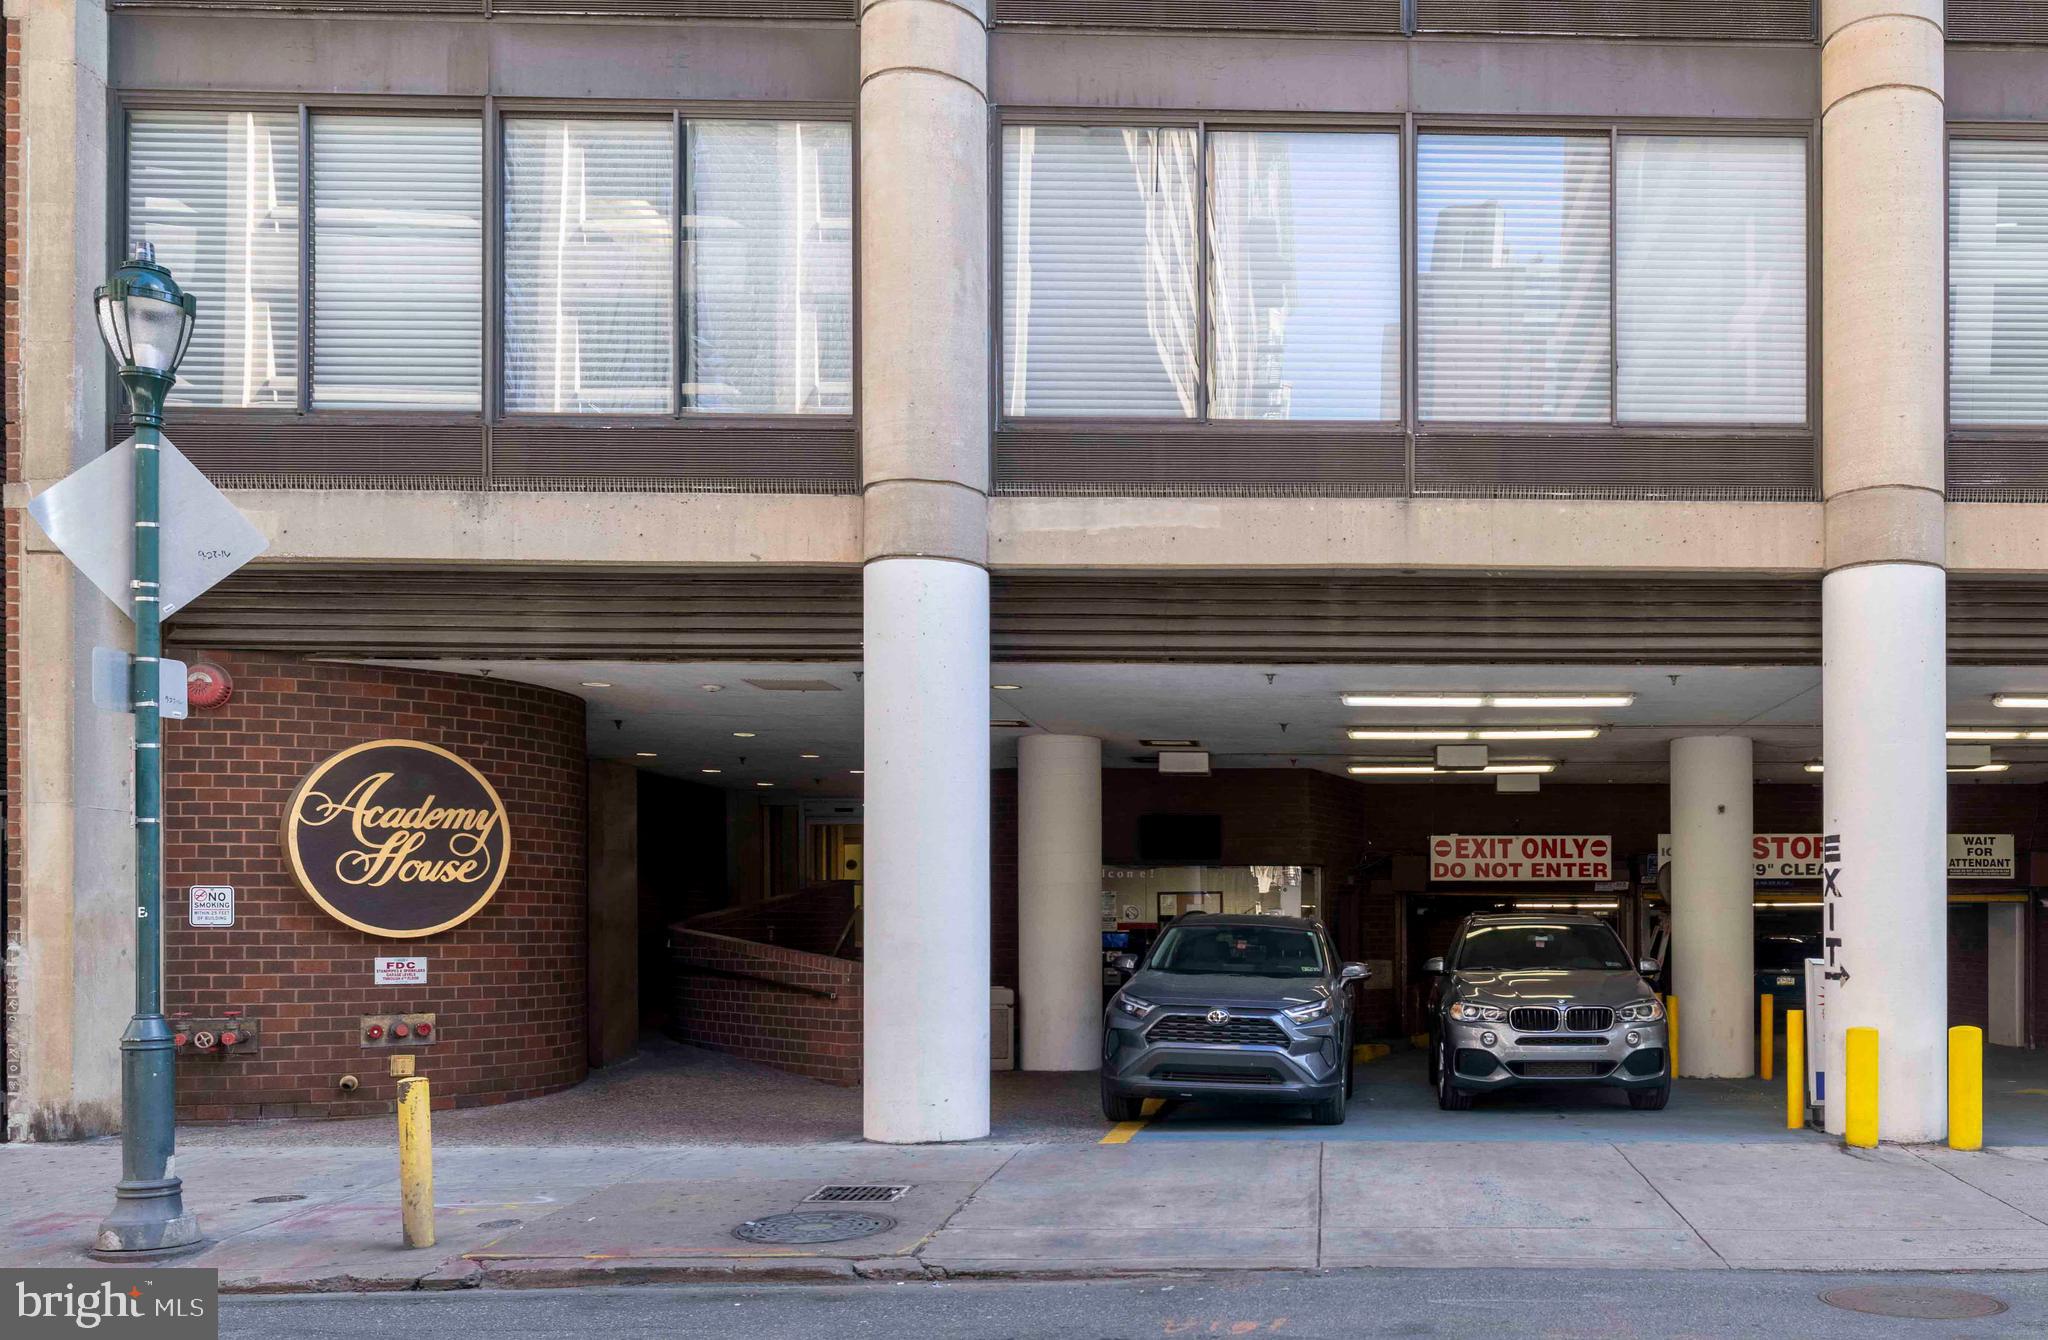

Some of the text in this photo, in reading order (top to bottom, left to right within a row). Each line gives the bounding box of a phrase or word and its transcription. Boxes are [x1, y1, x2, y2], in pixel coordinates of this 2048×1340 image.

[299, 772, 500, 857] Academy
[1455, 838, 1589, 859] EXIT ONLY
[1753, 836, 1824, 860] STOP
[1963, 836, 1997, 846] WAIT
[335, 830, 491, 887] House
[1967, 847, 1993, 857] FOR
[1433, 862, 1608, 878] DO NOT ENTER
[1948, 858, 2012, 868] ATTENDANT
[208, 892, 227, 902] NO
[1824, 834, 1843, 967] EXIT
